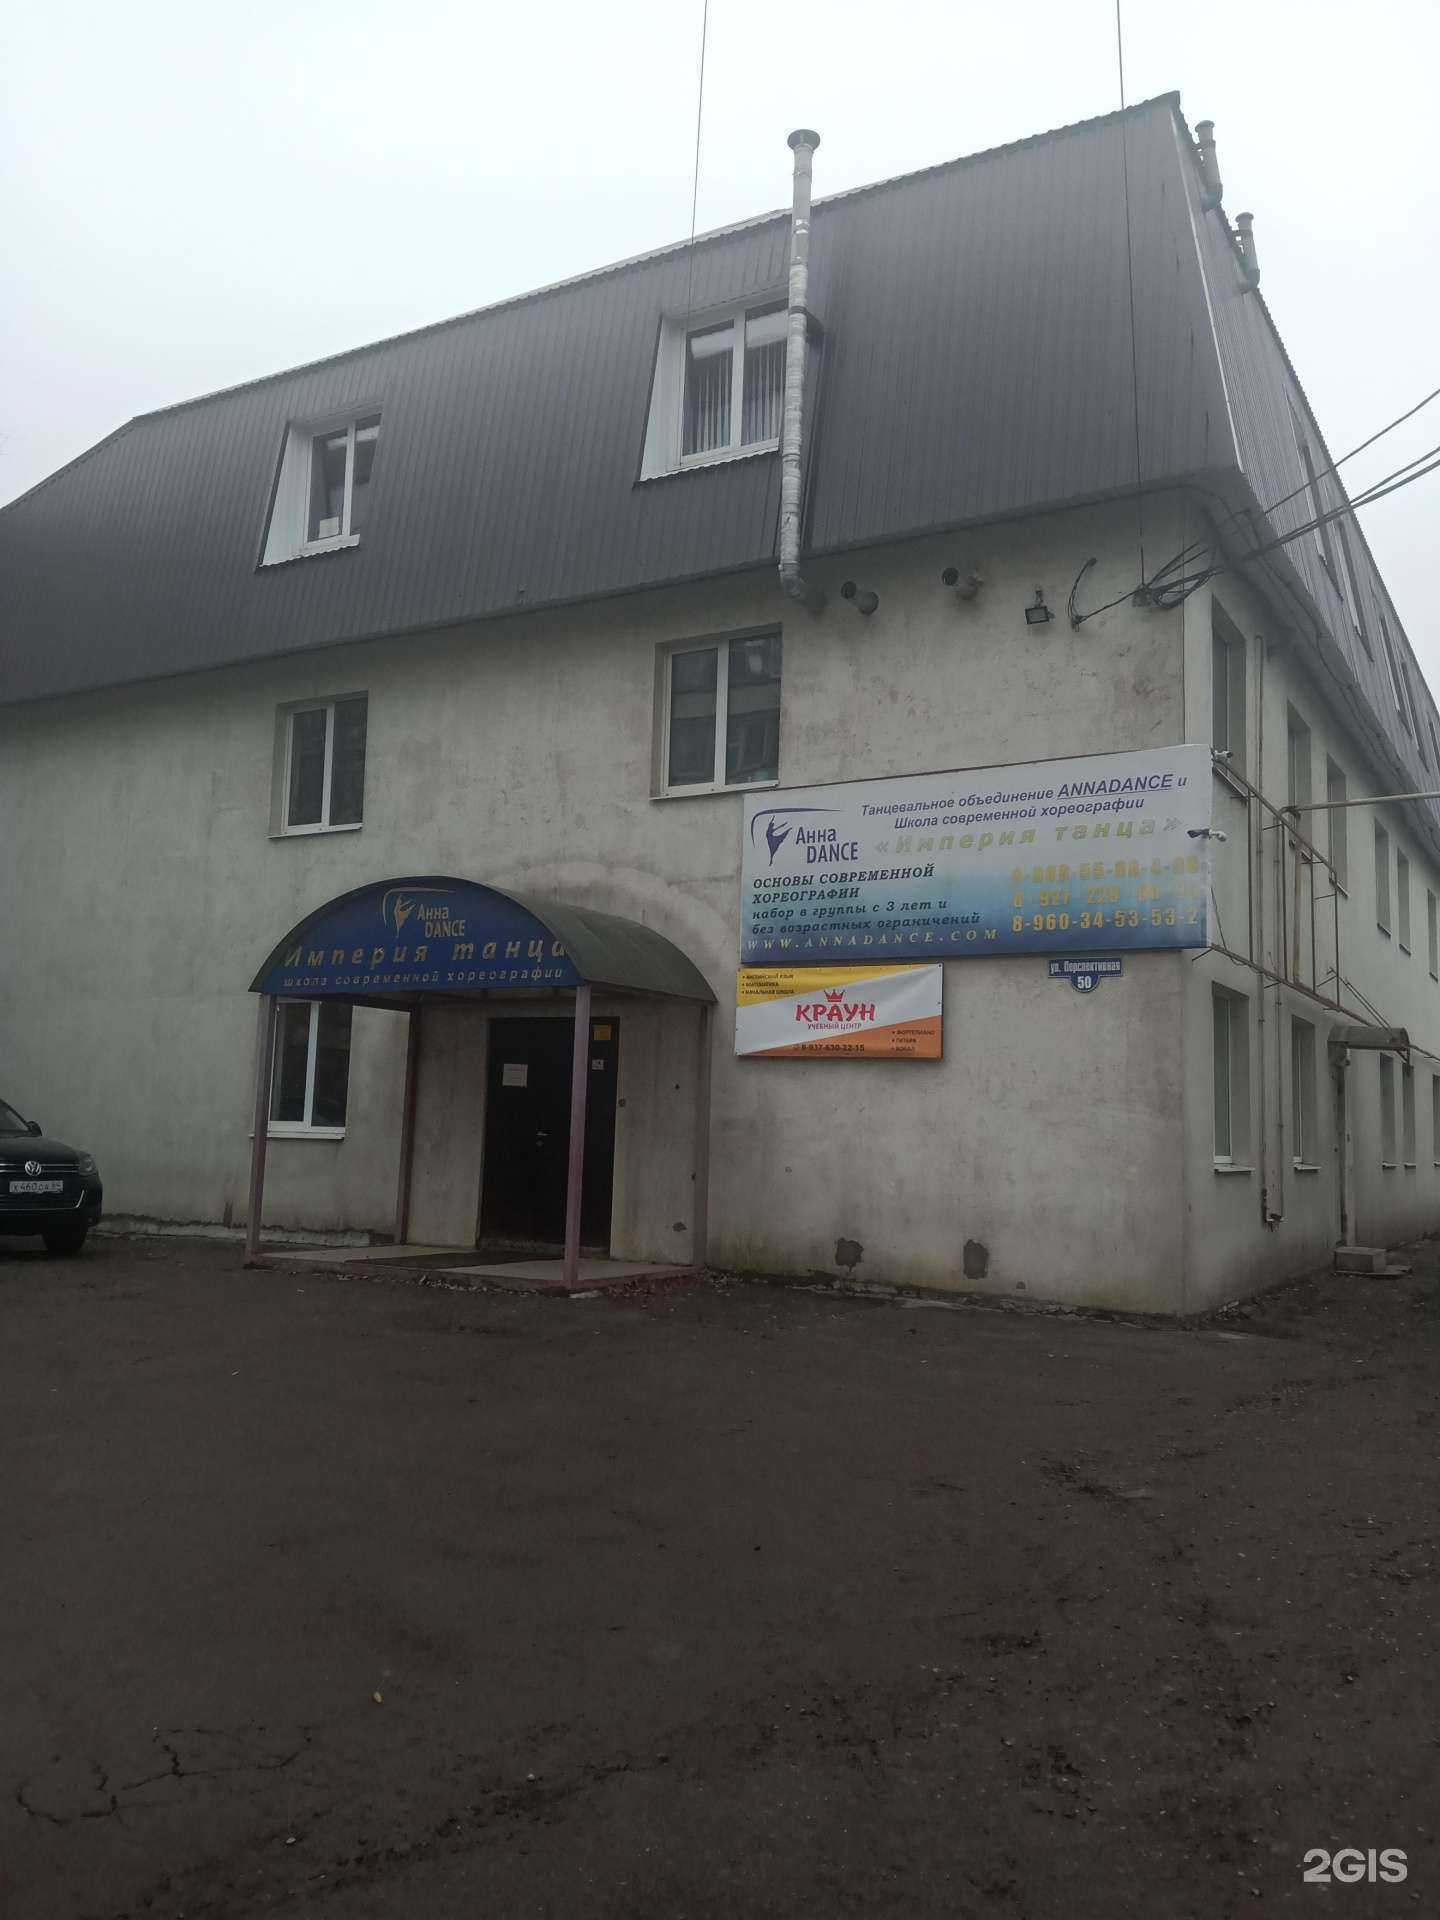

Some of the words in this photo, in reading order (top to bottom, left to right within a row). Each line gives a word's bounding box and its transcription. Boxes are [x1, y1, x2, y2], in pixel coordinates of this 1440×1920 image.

[861, 797, 955, 817] Танцевальное
[959, 788, 1054, 807] объединение
[1057, 773, 1174, 798] ANNADANCE
[1177, 776, 1188, 788] и
[894, 815, 938, 829] Школа
[942, 805, 1036, 826] современной
[1041, 797, 1145, 817] хореографии
[795, 826, 837, 845] Анна
[807, 841, 859, 864] DANCE
[753, 875, 814, 889] ОСНОВЫ
[819, 863, 935, 884] СОВРЕМЕННОЙ
[752, 887, 860, 904] ХОРЕОГРАФИИ
[416, 904, 450, 920] Анна
[752, 907, 794, 919] набор
[799, 908, 808, 917] в
[813, 904, 866, 919] группы
[872, 904, 880, 912] с
[886, 901, 895, 912] 3
[900, 901, 932, 912] лет
[938, 899, 948, 909] и
[425, 919, 466, 938] DANCE
[752, 922, 775, 935] без
[780, 920, 872, 935] возрастных
[877, 912, 981, 931] ограничений
[284, 945, 428, 970] Империя
[1050, 962, 1062, 975] ул.
[1064, 960, 1121, 974] Перспективная
[284, 977, 328, 987] школа
[335, 971, 440, 988] современной
[447, 965, 562, 982] хореографии
[1077, 975, 1092, 989] 50
[795, 1002, 876, 1023] КРАУН
[807, 1022, 839, 1031] УЧЕБНЫЙ
[840, 1022, 862, 1031] ЦЕНТР
